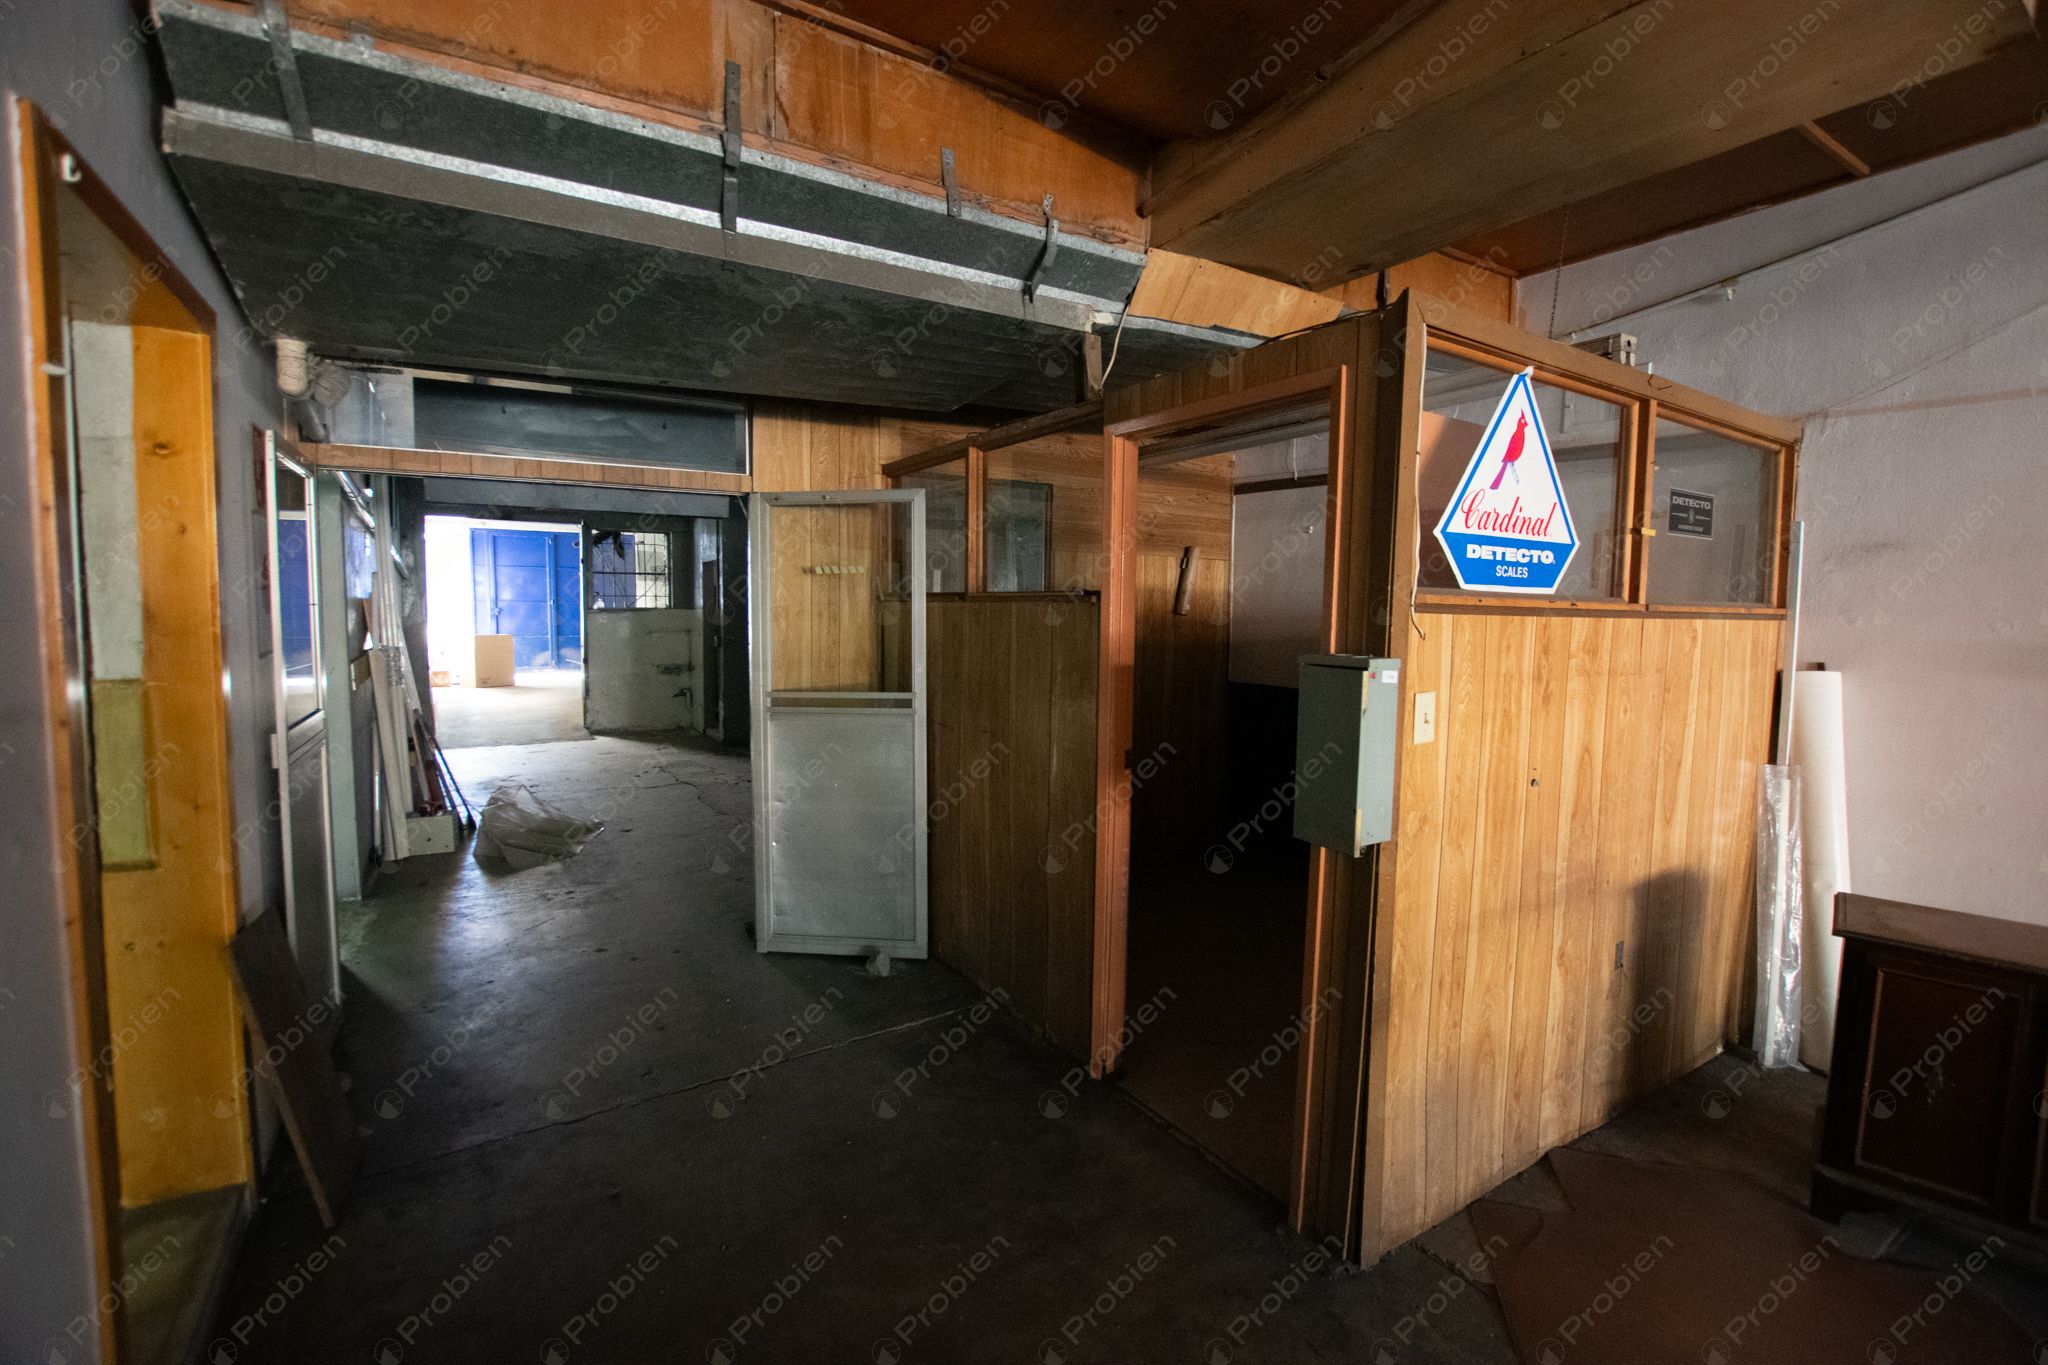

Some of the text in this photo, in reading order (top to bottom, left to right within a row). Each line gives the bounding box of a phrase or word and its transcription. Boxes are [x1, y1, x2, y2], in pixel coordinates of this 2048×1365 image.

[1672, 496, 1711, 510] DETECTO
[1460, 488, 1557, 537] Cardinal
[1466, 544, 1554, 564] DETECTO
[1495, 565, 1528, 578] SCALES
